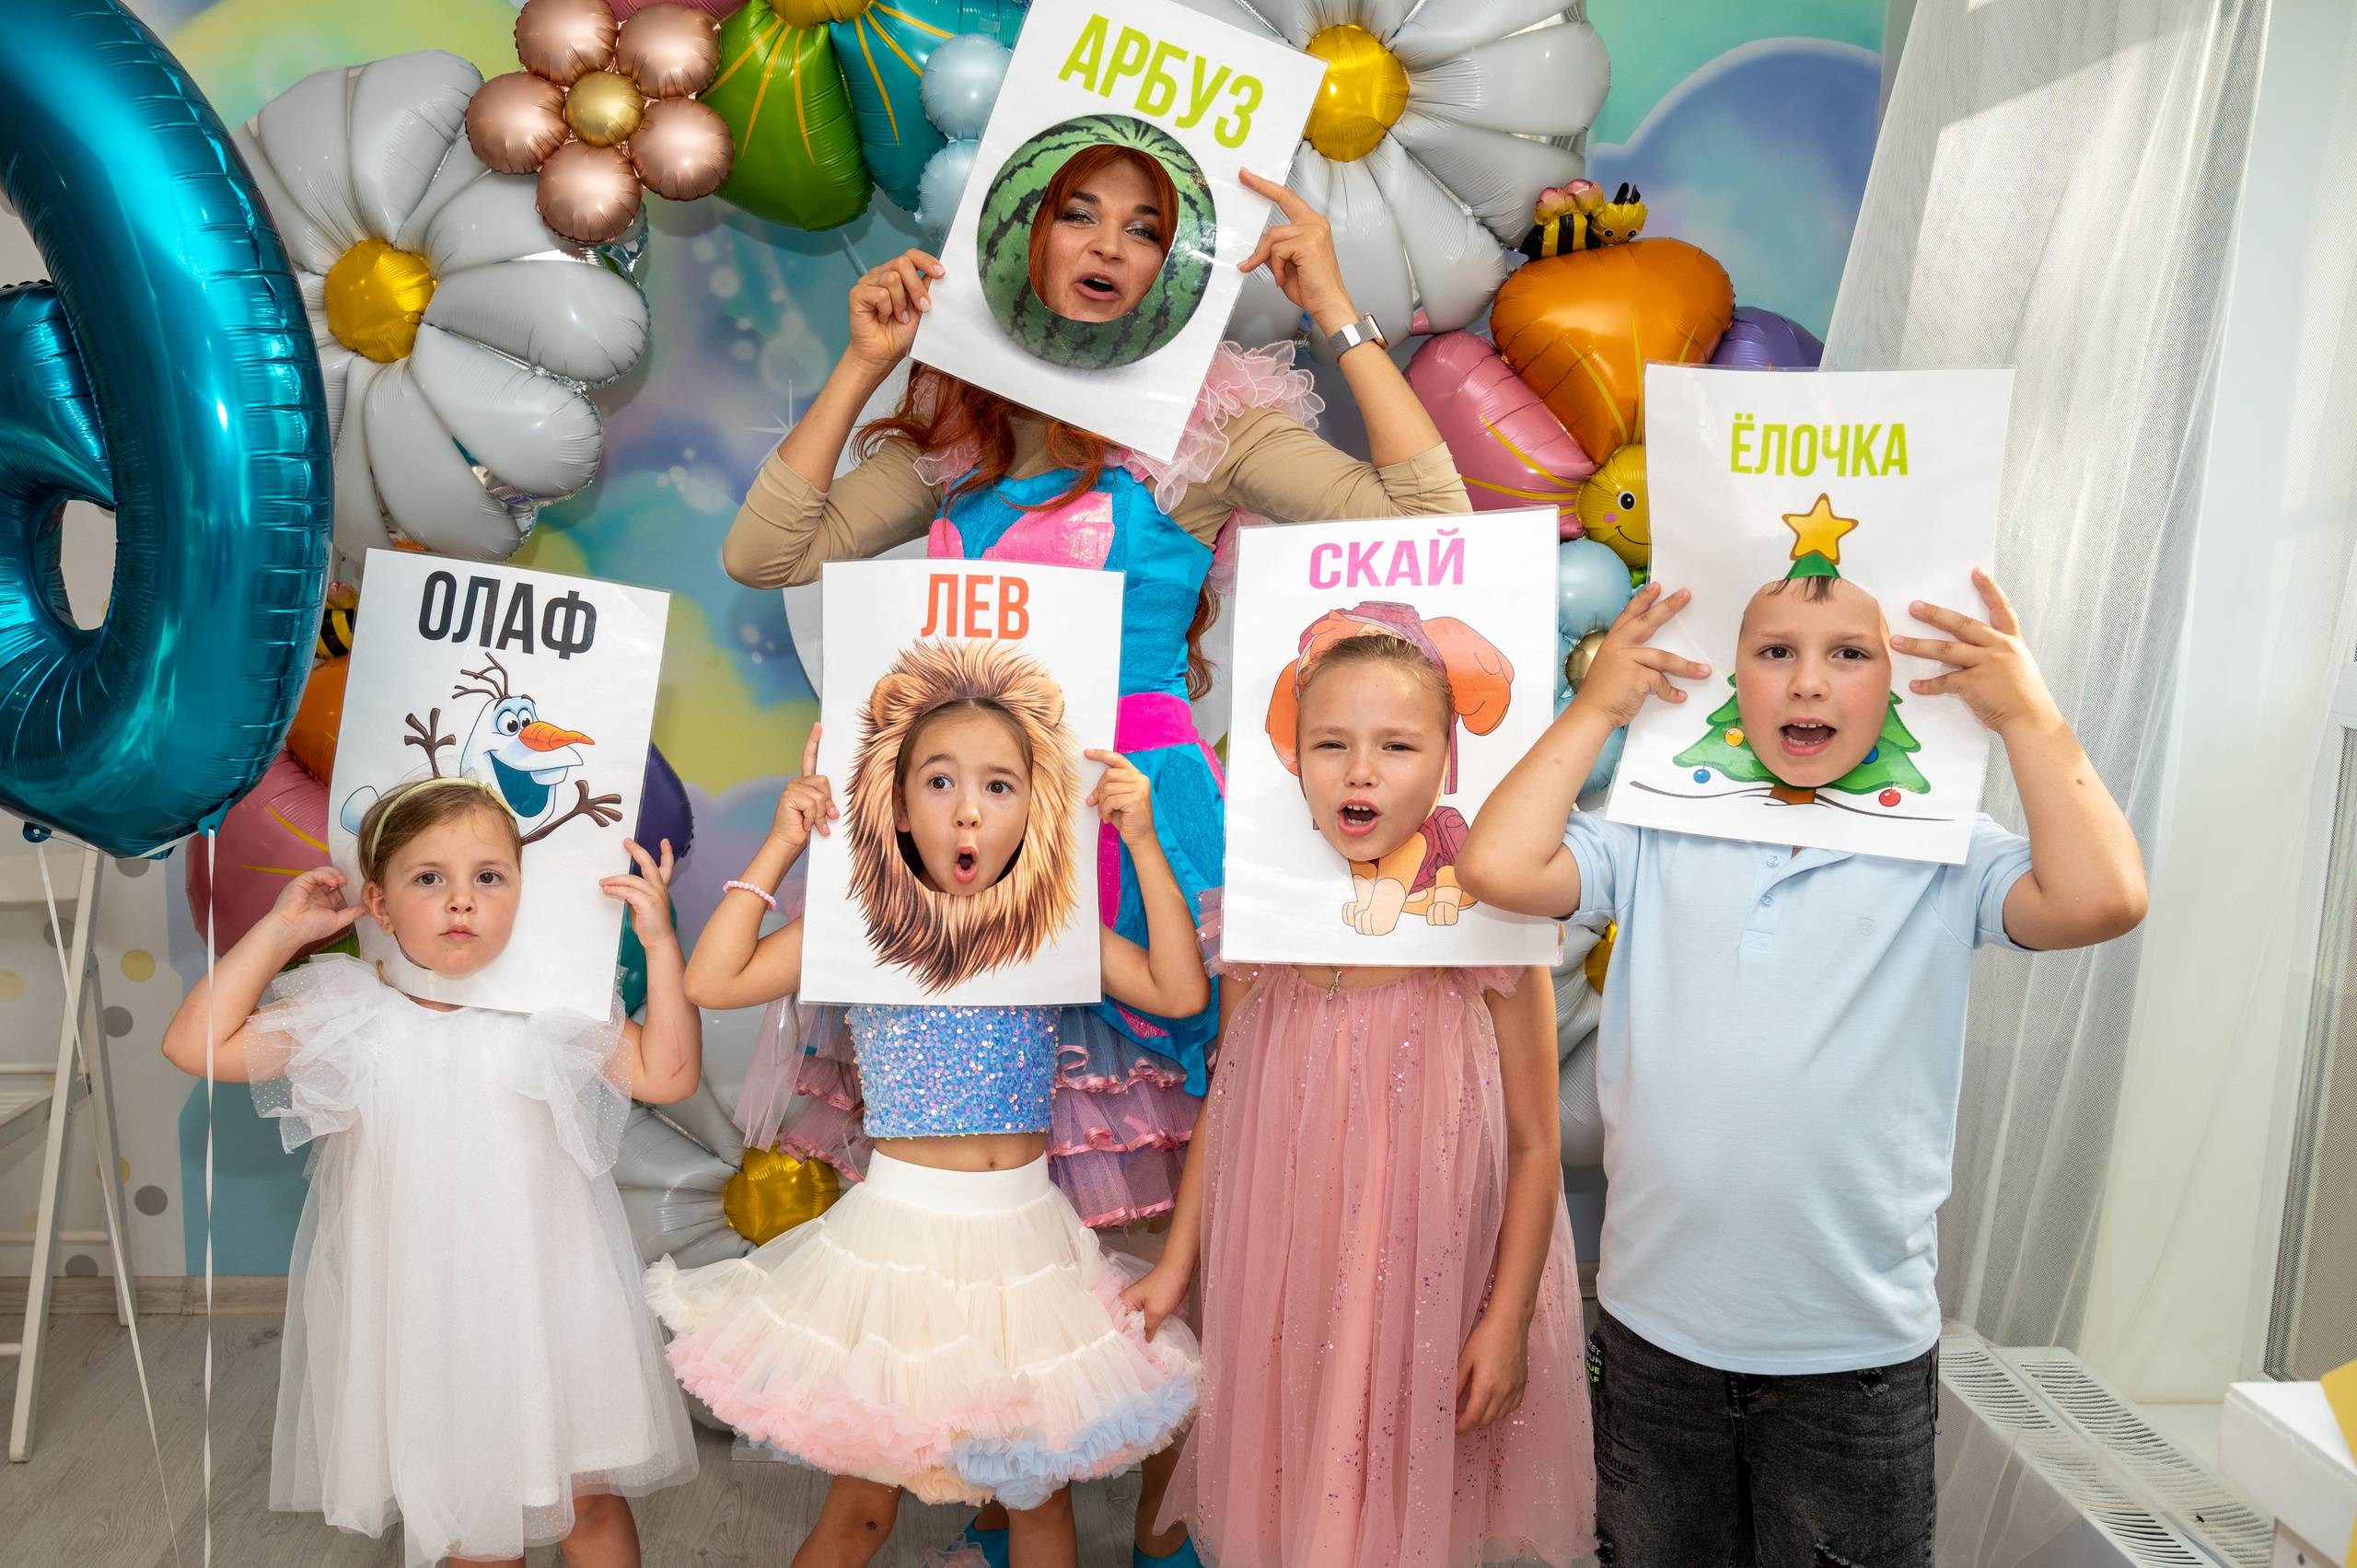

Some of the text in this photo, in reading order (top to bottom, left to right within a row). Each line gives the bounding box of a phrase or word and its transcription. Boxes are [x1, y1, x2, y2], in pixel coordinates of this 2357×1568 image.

[1058, 13, 1264, 149] АРБУЗ
[1730, 412, 1909, 478] ЁЛОЧКА
[1308, 528, 1465, 590] СКАЙ
[418, 570, 597, 660] ОЛАФ
[920, 574, 1029, 640] ЛЕВ
[1588, 1340, 1601, 1355] EET
